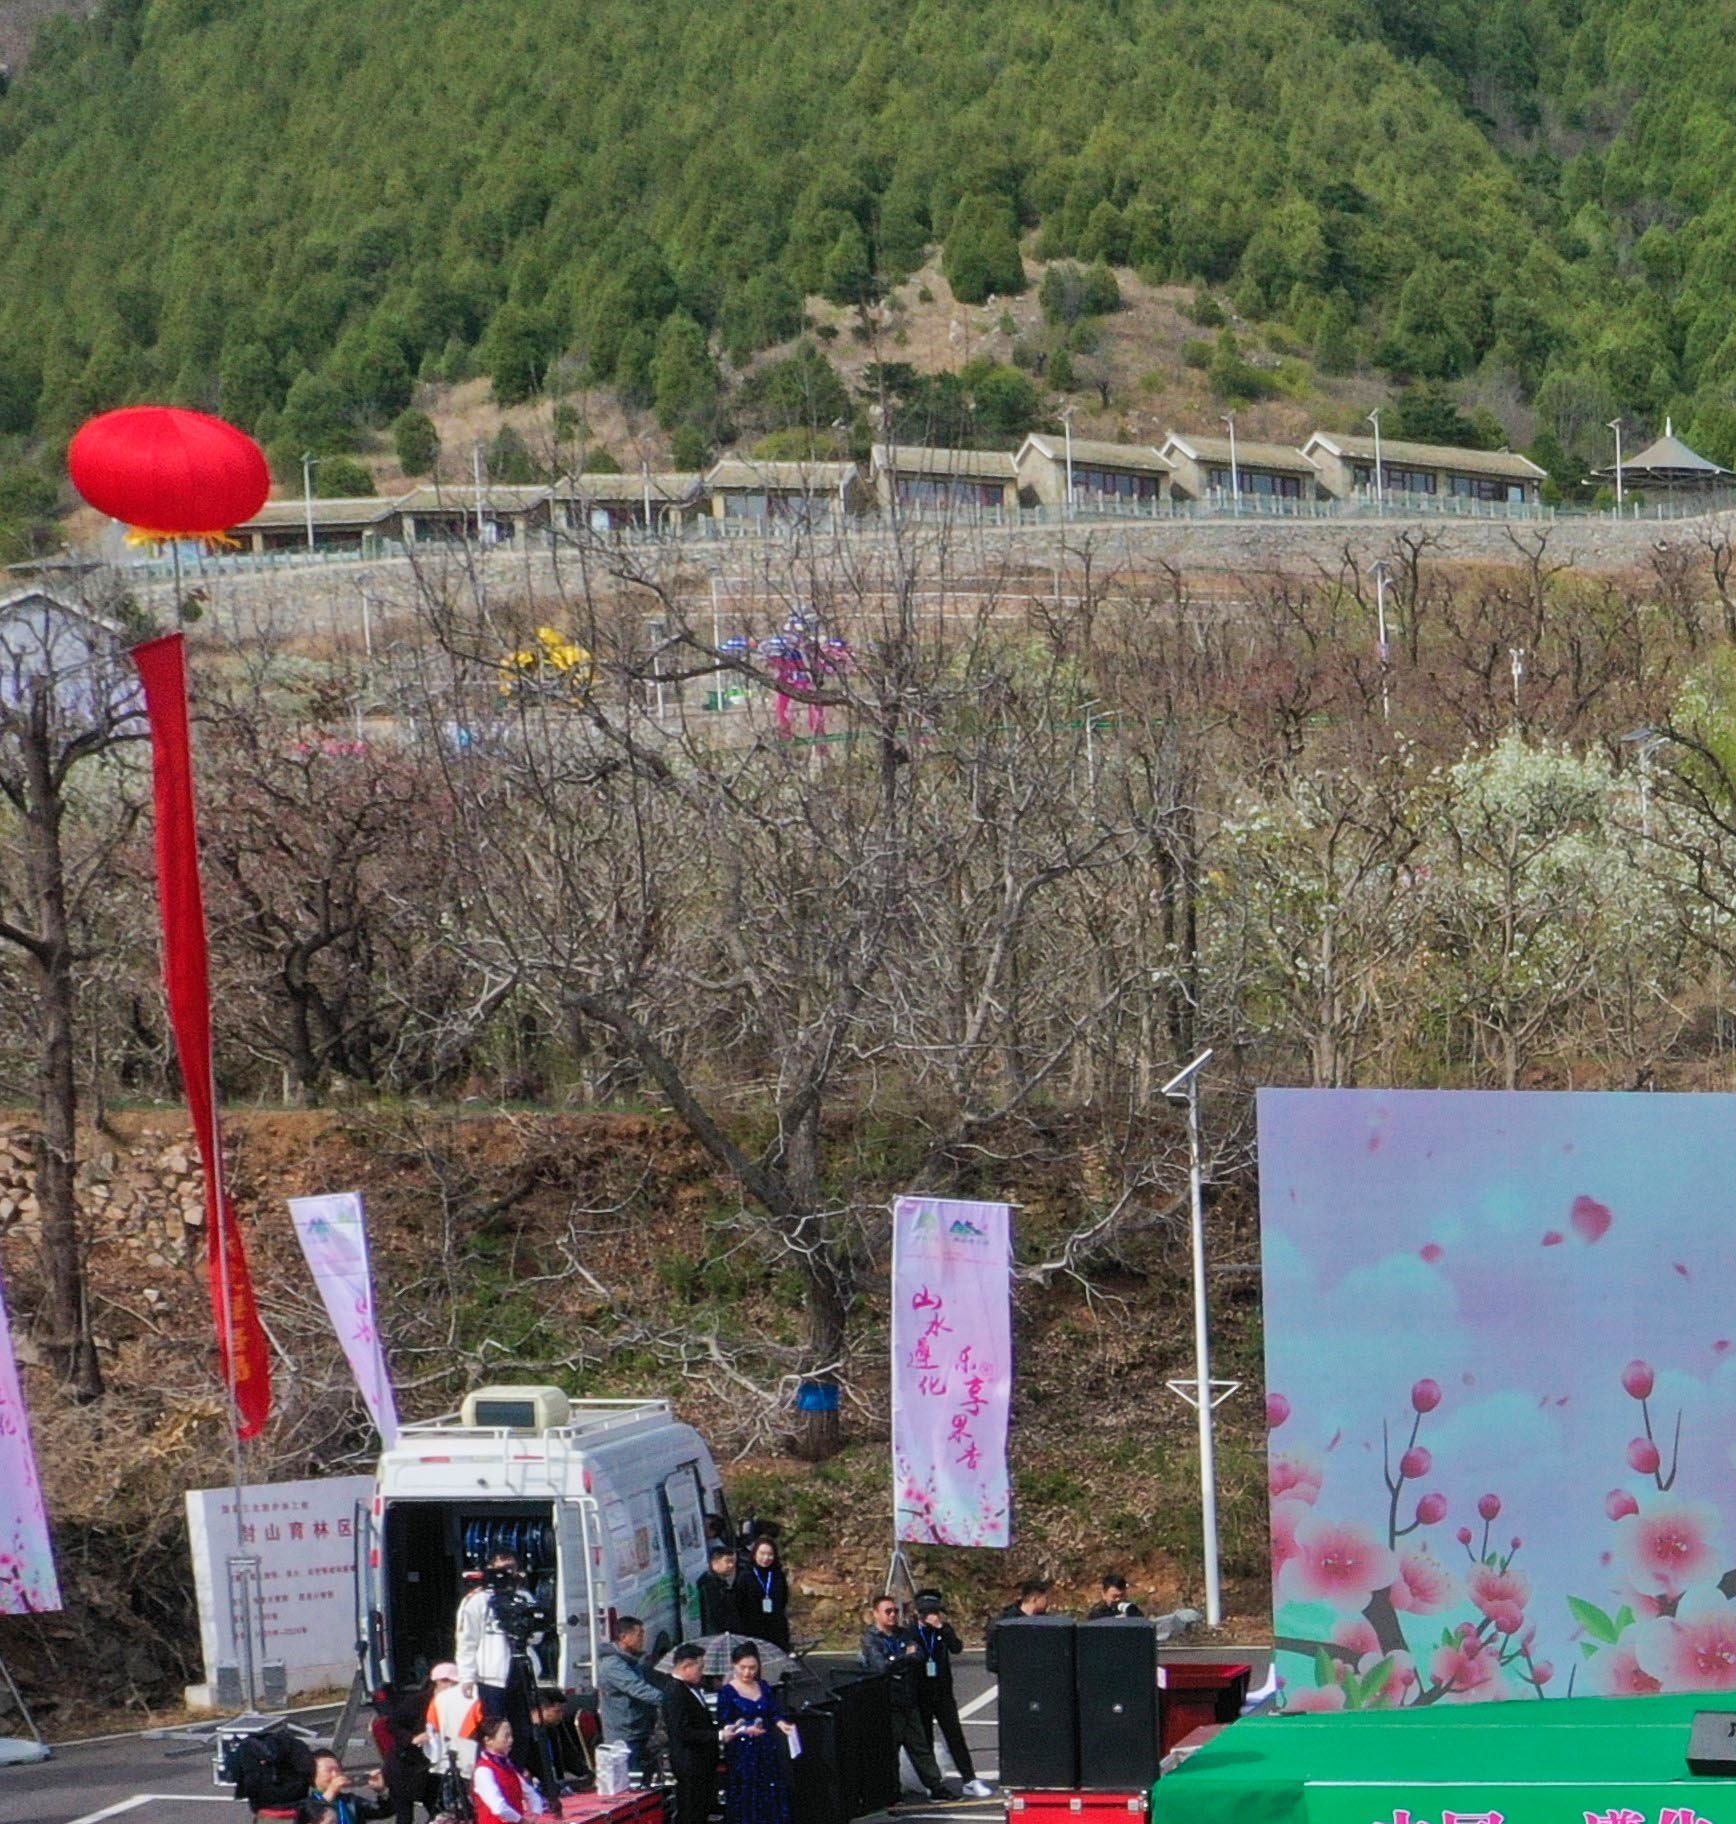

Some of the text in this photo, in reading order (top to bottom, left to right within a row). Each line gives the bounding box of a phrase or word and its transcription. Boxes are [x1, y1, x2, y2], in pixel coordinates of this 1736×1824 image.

[907, 1285, 953, 1396] 山水遵化
[948, 1346, 990, 1470] 乐享果香
